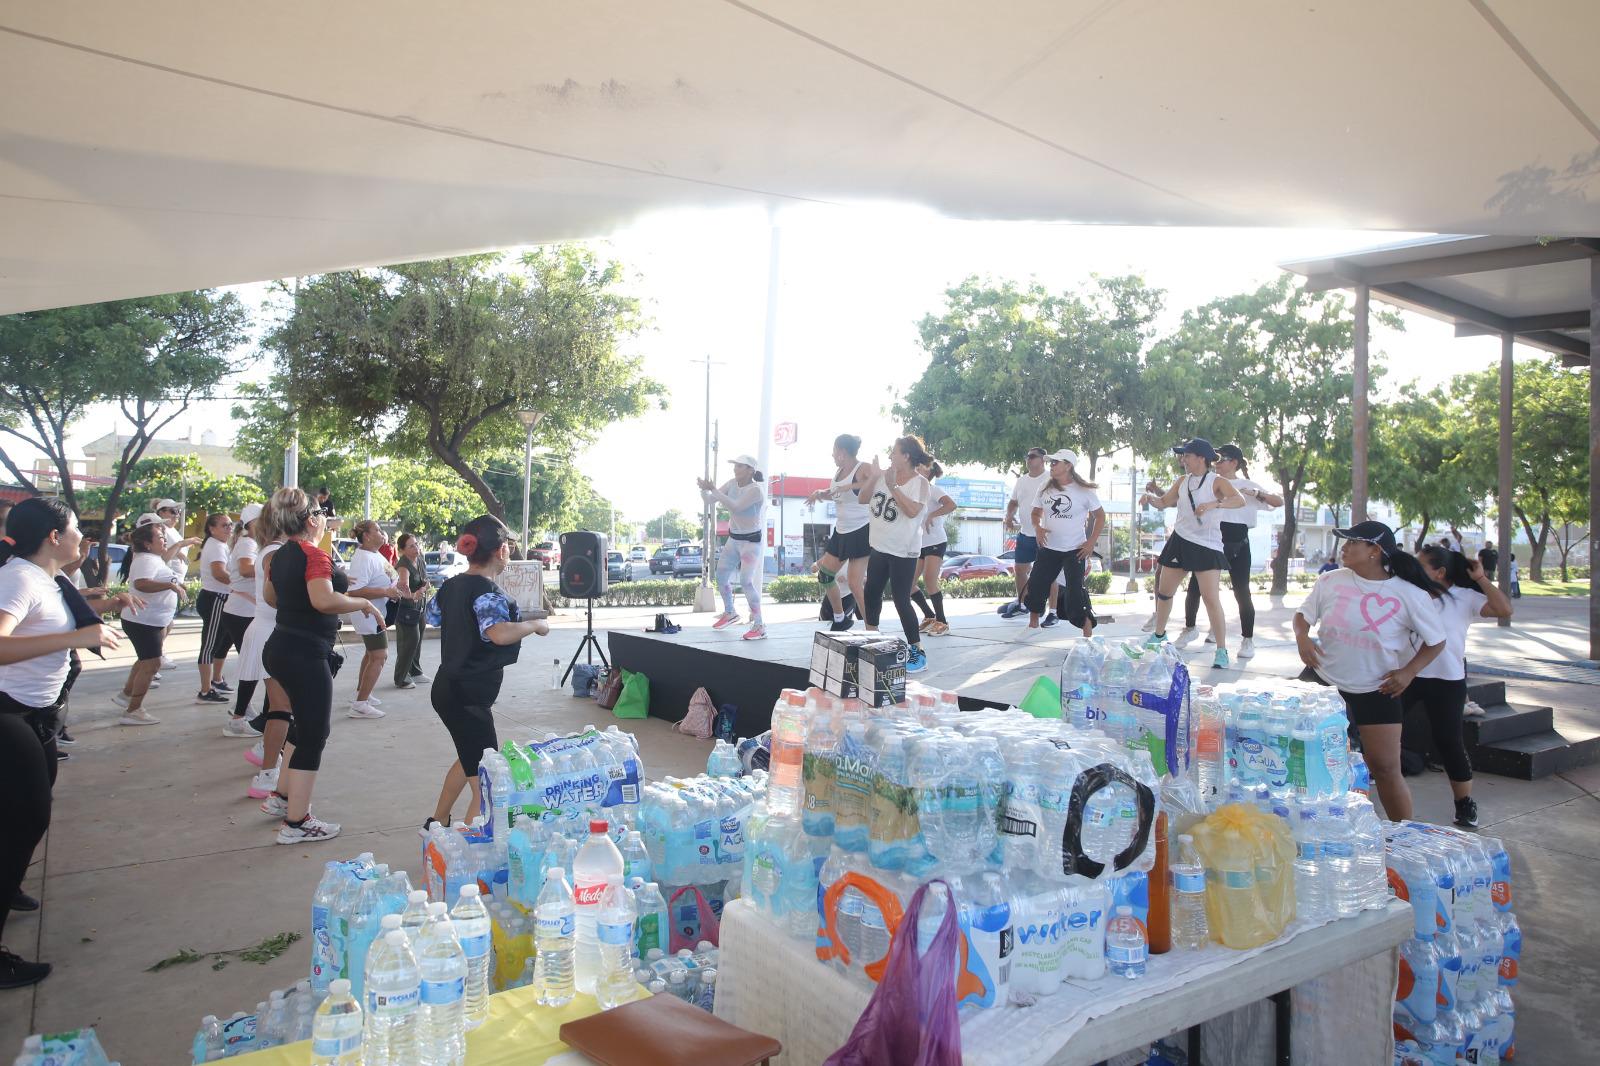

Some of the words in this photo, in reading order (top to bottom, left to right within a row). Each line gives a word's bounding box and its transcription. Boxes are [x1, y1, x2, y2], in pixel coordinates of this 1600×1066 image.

[872, 492, 898, 521] 36
[1131, 691, 1140, 705] 6
[1248, 755, 1277, 769] AGUA
[540, 783, 604, 810] WATER
[1491, 883, 1505, 893] 45
[1017, 910, 1102, 945] water
